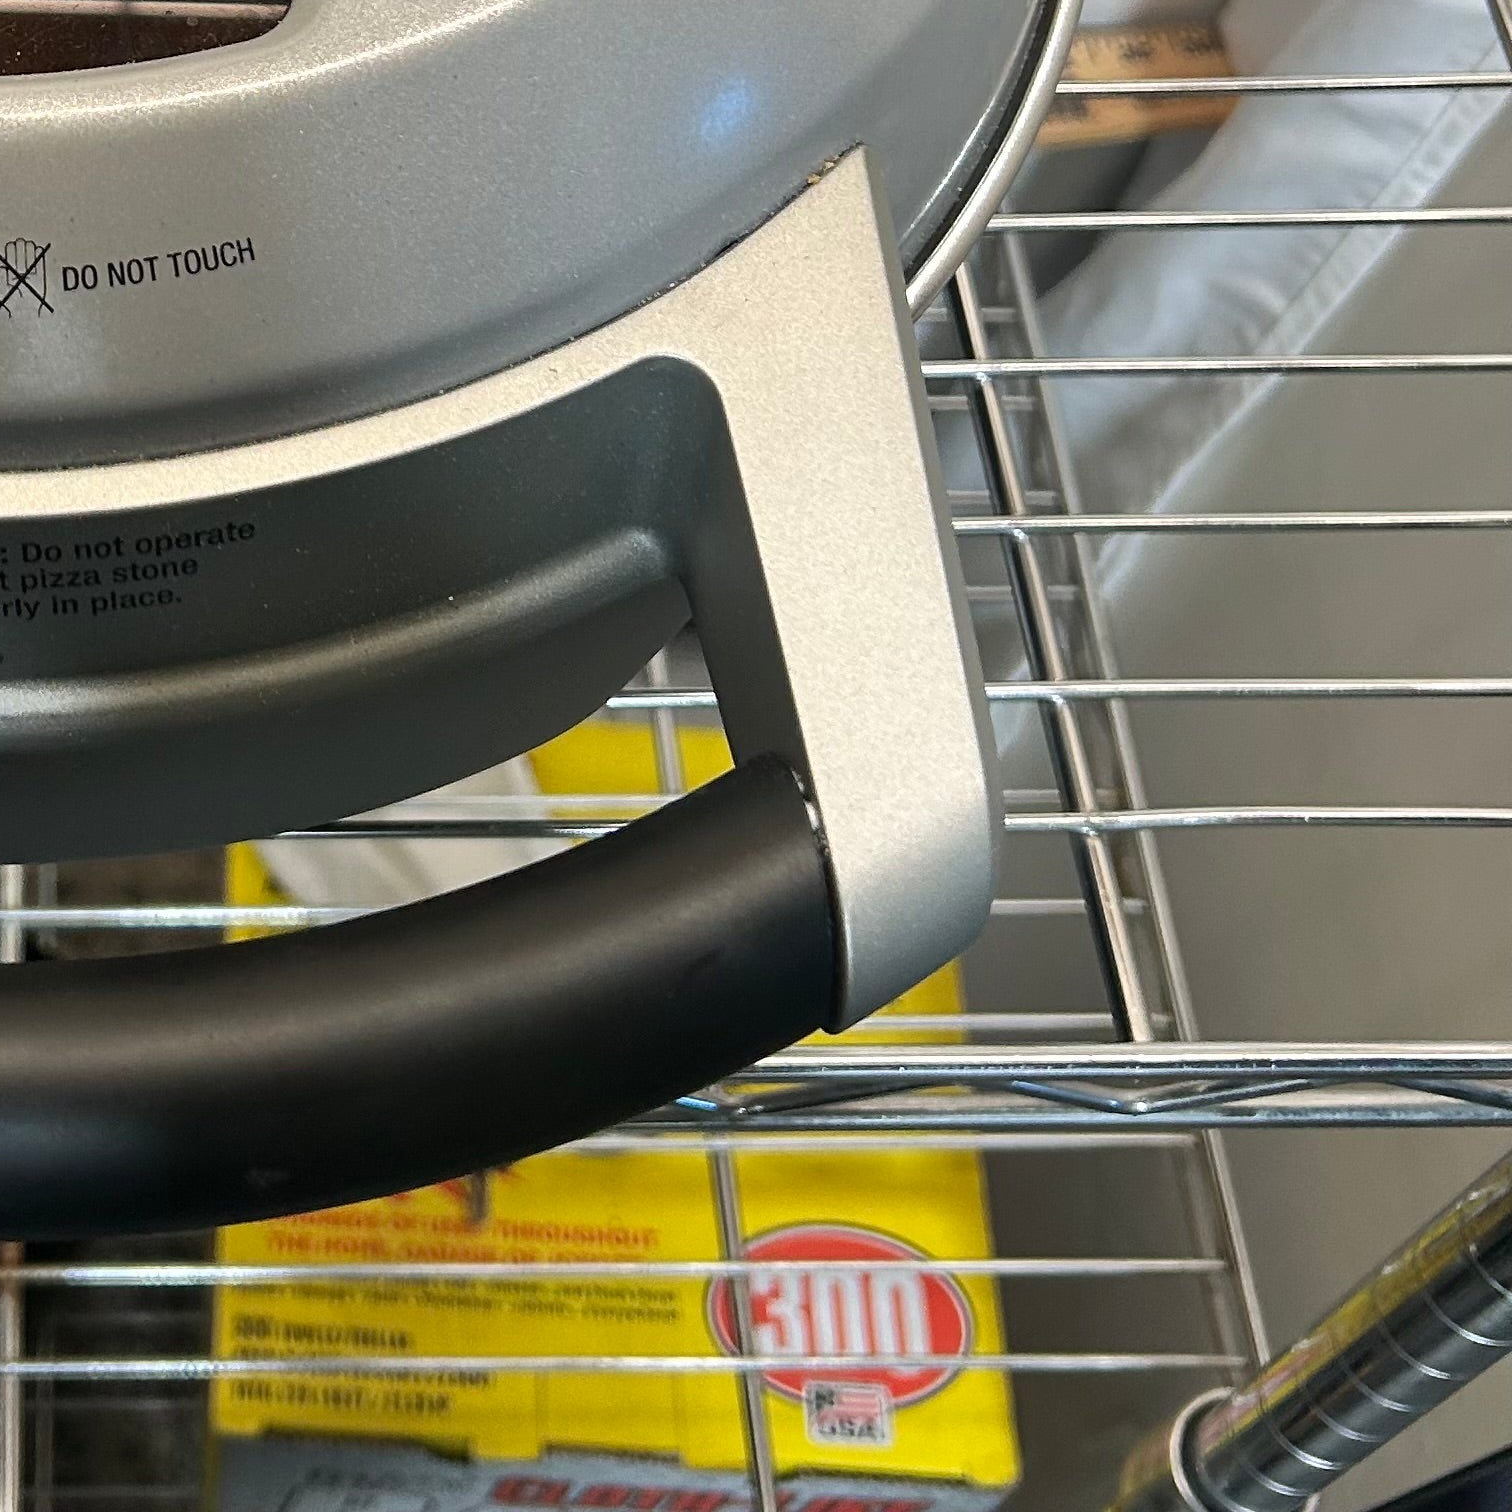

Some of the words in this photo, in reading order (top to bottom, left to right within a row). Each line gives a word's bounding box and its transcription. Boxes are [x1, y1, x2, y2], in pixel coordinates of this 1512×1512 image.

[62, 265, 98, 291] DO
[108, 256, 159, 289] NOT
[167, 237, 256, 278] TOUCH
[21, 542, 62, 563] Do
[74, 537, 124, 561] not
[135, 521, 256, 558] operate
[21, 568, 102, 593] pizza
[113, 557, 199, 584] stone
[52, 596, 80, 616] in
[91, 588, 183, 617] place.
[746, 1266, 930, 1376] 300
